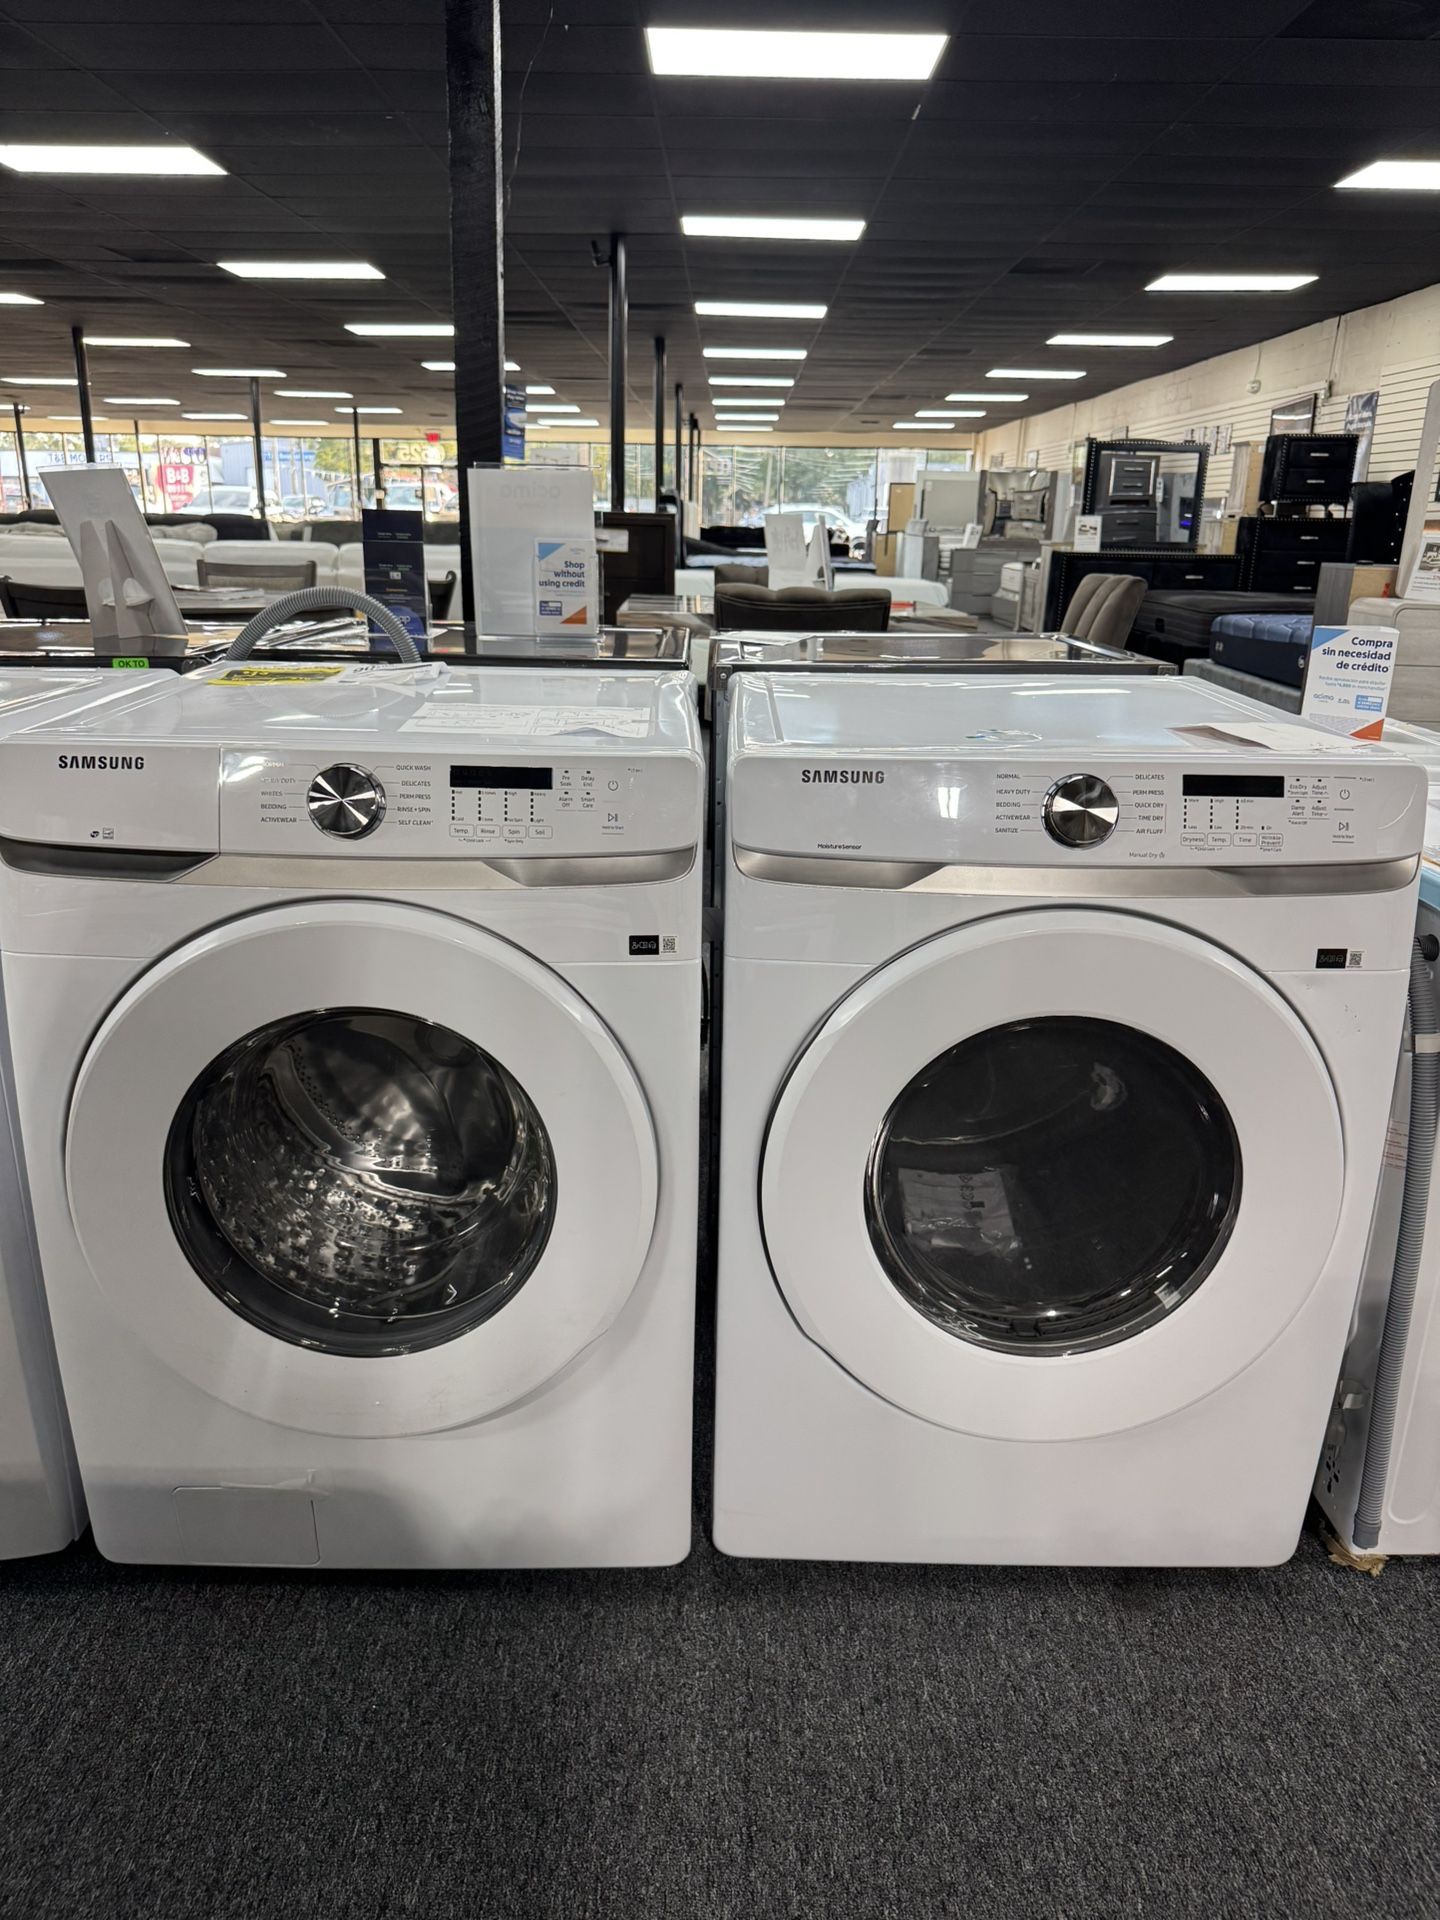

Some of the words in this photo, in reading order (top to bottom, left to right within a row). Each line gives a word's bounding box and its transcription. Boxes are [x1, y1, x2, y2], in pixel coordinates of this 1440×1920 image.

[564, 560, 585, 569] Shop
[554, 570, 585, 578] without
[538, 580, 561, 588] using
[562, 580, 585, 588] credit
[1351, 636, 1393, 649] Compra
[1322, 647, 1336, 656] sin
[1338, 649, 1391, 661] necesidad
[118, 659, 132, 668] OK
[132, 660, 146, 668] TO
[1336, 660, 1350, 670] de
[58, 755, 145, 770] SAMSUNG
[801, 769, 886, 784] SAMSUNG
[1312, 784, 1328, 792] Adjust
[508, 828, 520, 836] Spin
[535, 828, 546, 836] Soil
[1182, 836, 1204, 844] Dryness
[1148, 852, 1158, 860] Dry
